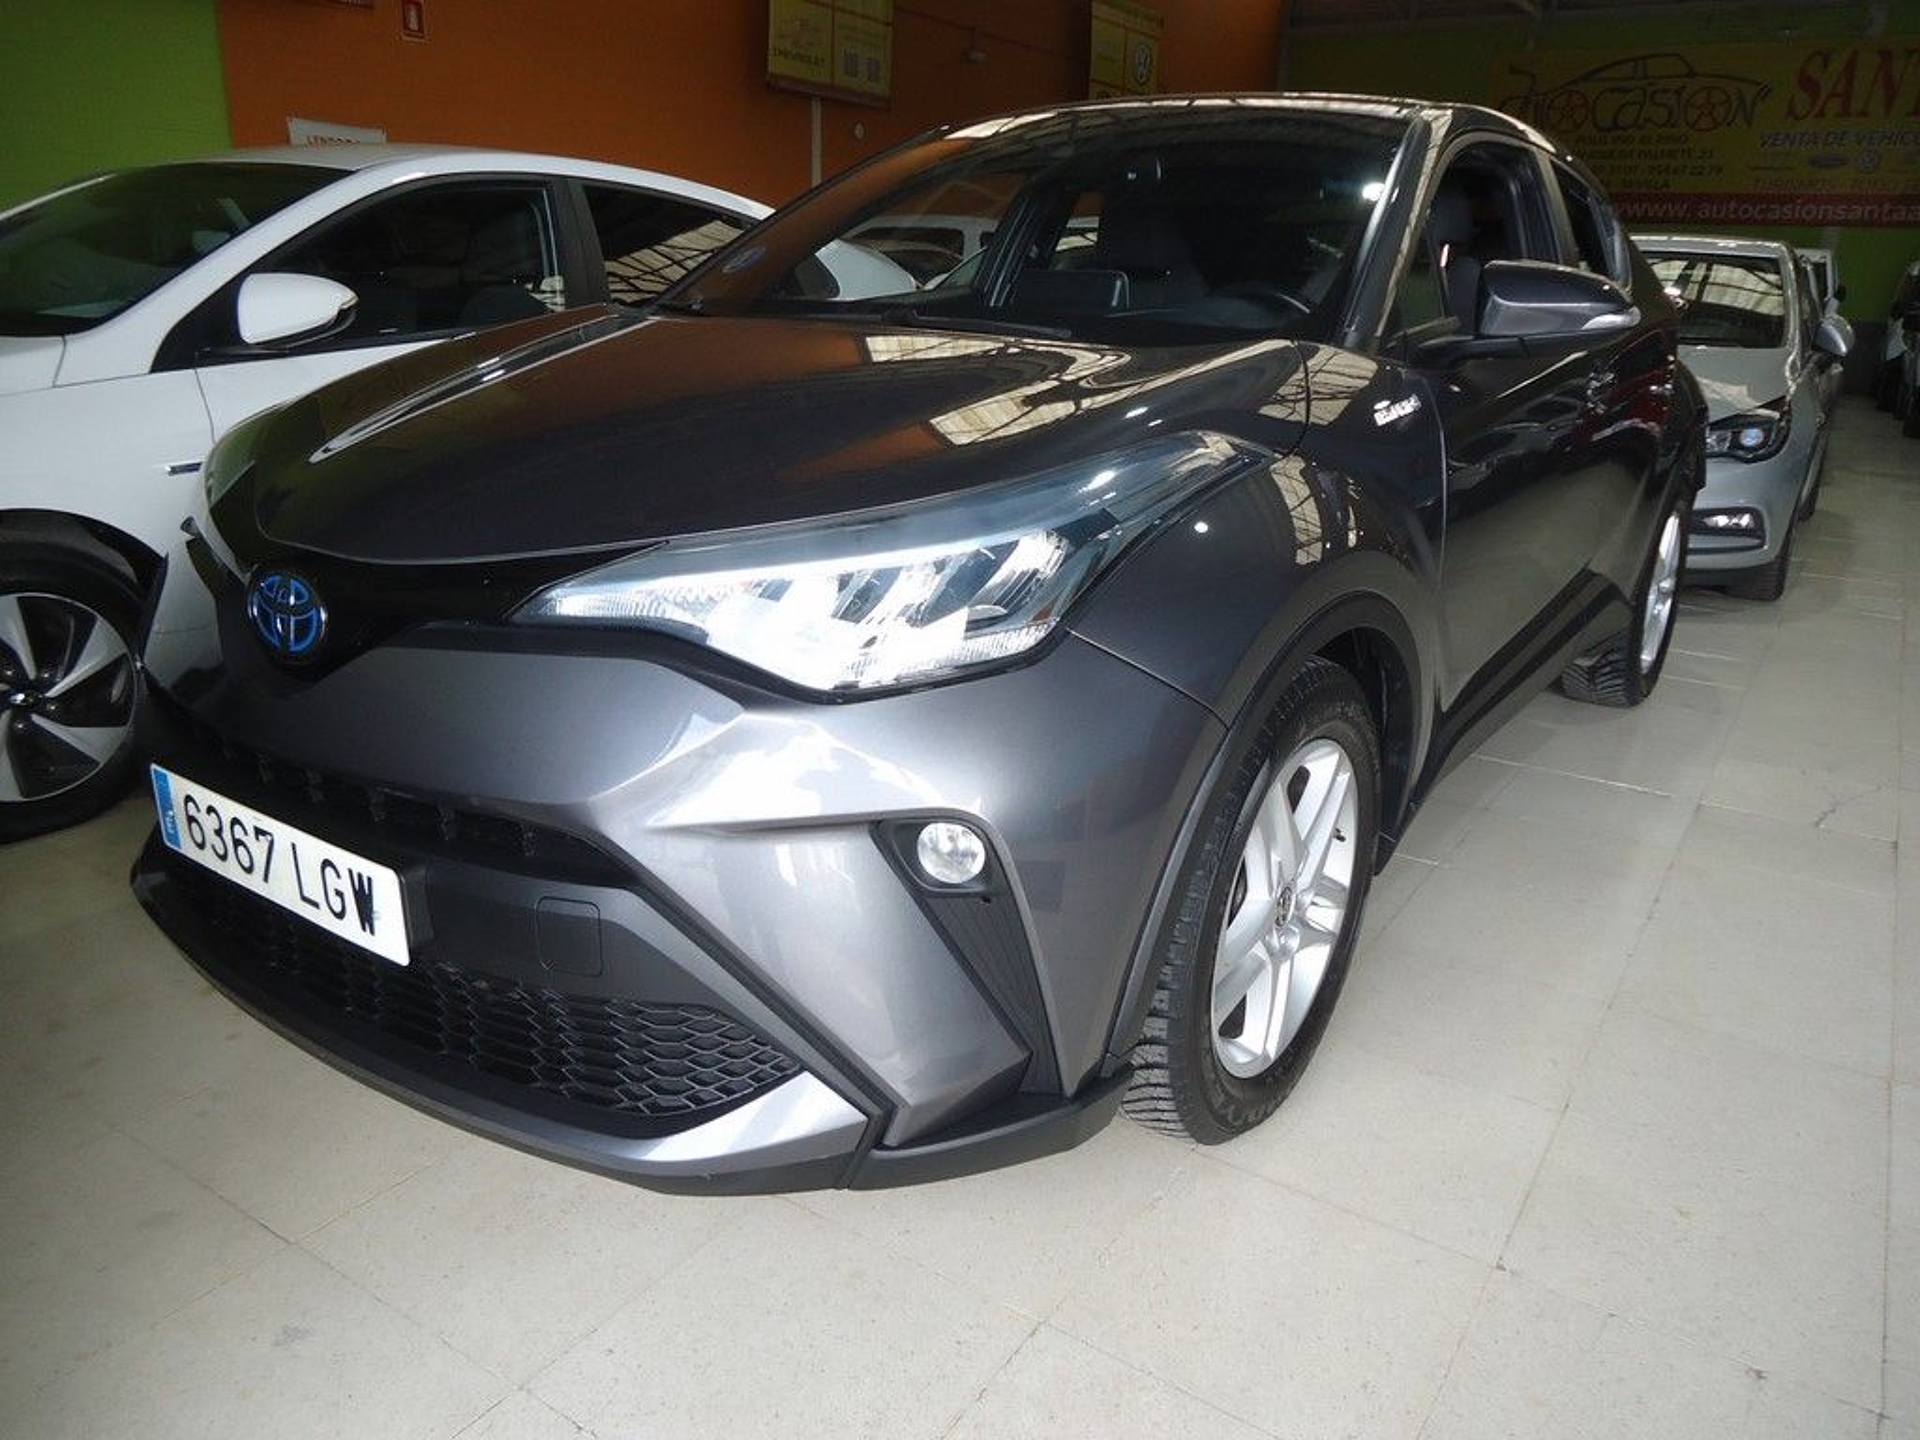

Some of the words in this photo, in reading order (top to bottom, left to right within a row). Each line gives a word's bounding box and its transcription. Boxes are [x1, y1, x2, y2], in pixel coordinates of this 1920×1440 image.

[1822, 130, 1848, 148] DE
[183, 794, 275, 883] 6367
[291, 842, 376, 937] LGW
